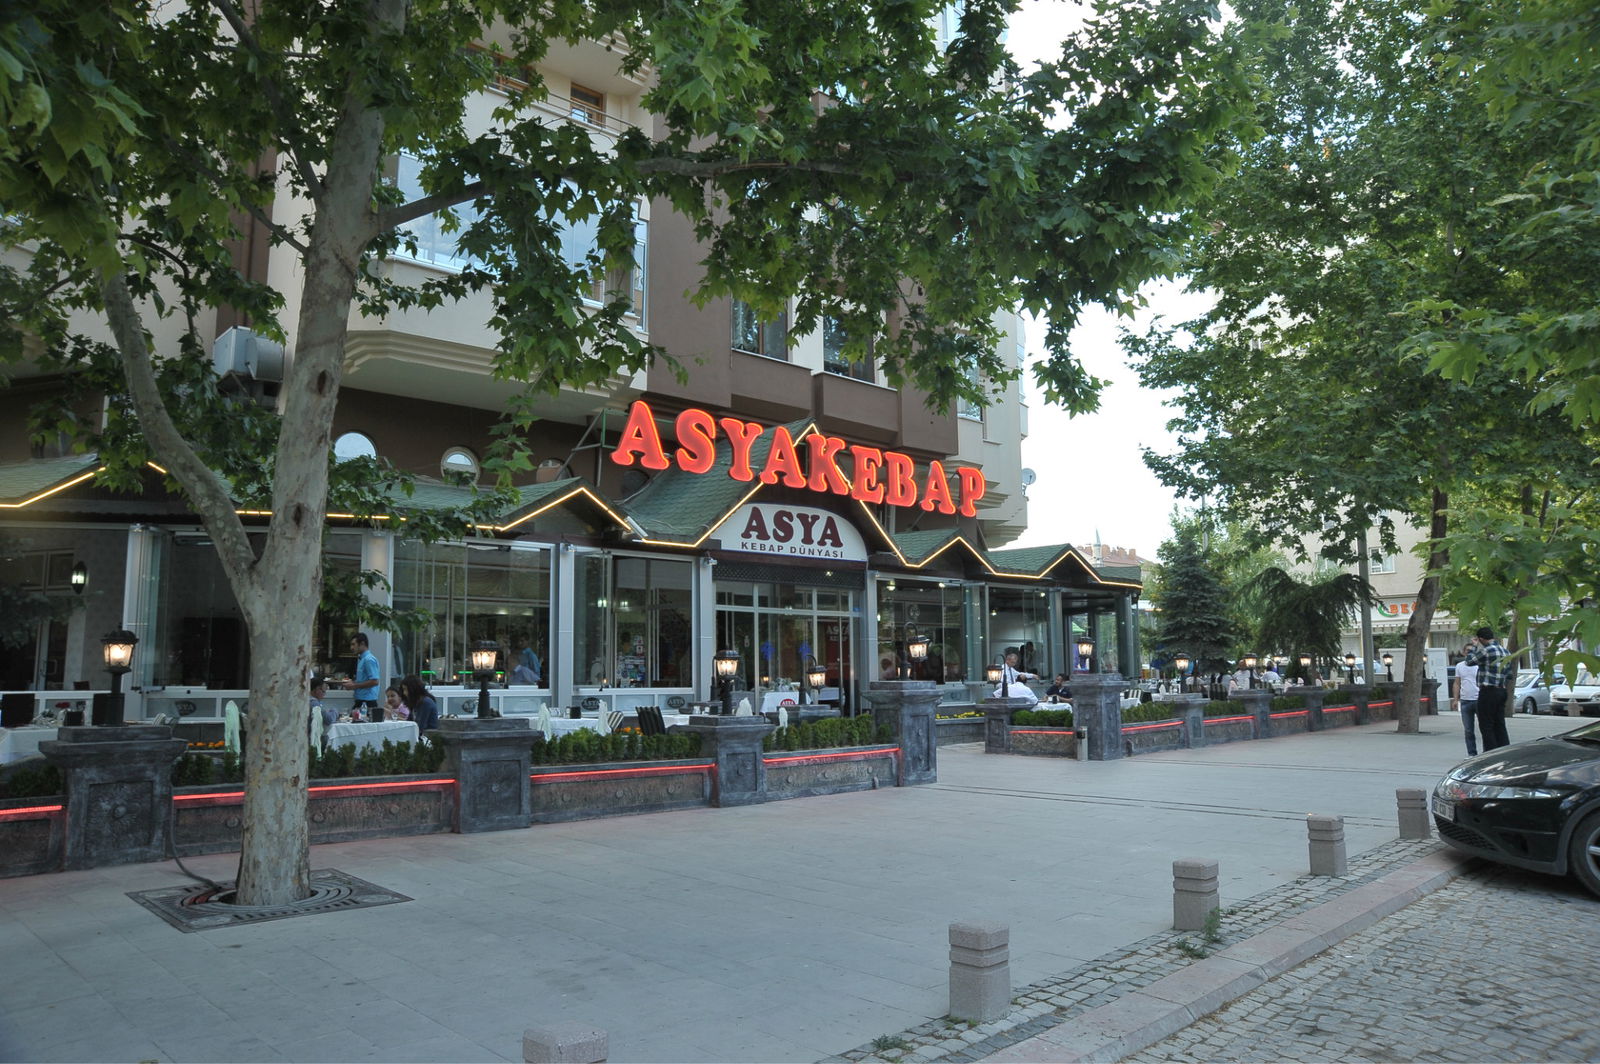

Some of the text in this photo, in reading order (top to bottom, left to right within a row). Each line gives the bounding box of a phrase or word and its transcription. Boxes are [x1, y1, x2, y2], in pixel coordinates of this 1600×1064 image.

[611, 400, 985, 518] ASYAKEBAP
[741, 506, 843, 549] ASYA
[741, 541, 844, 559] KEBAP DÜNYASI
